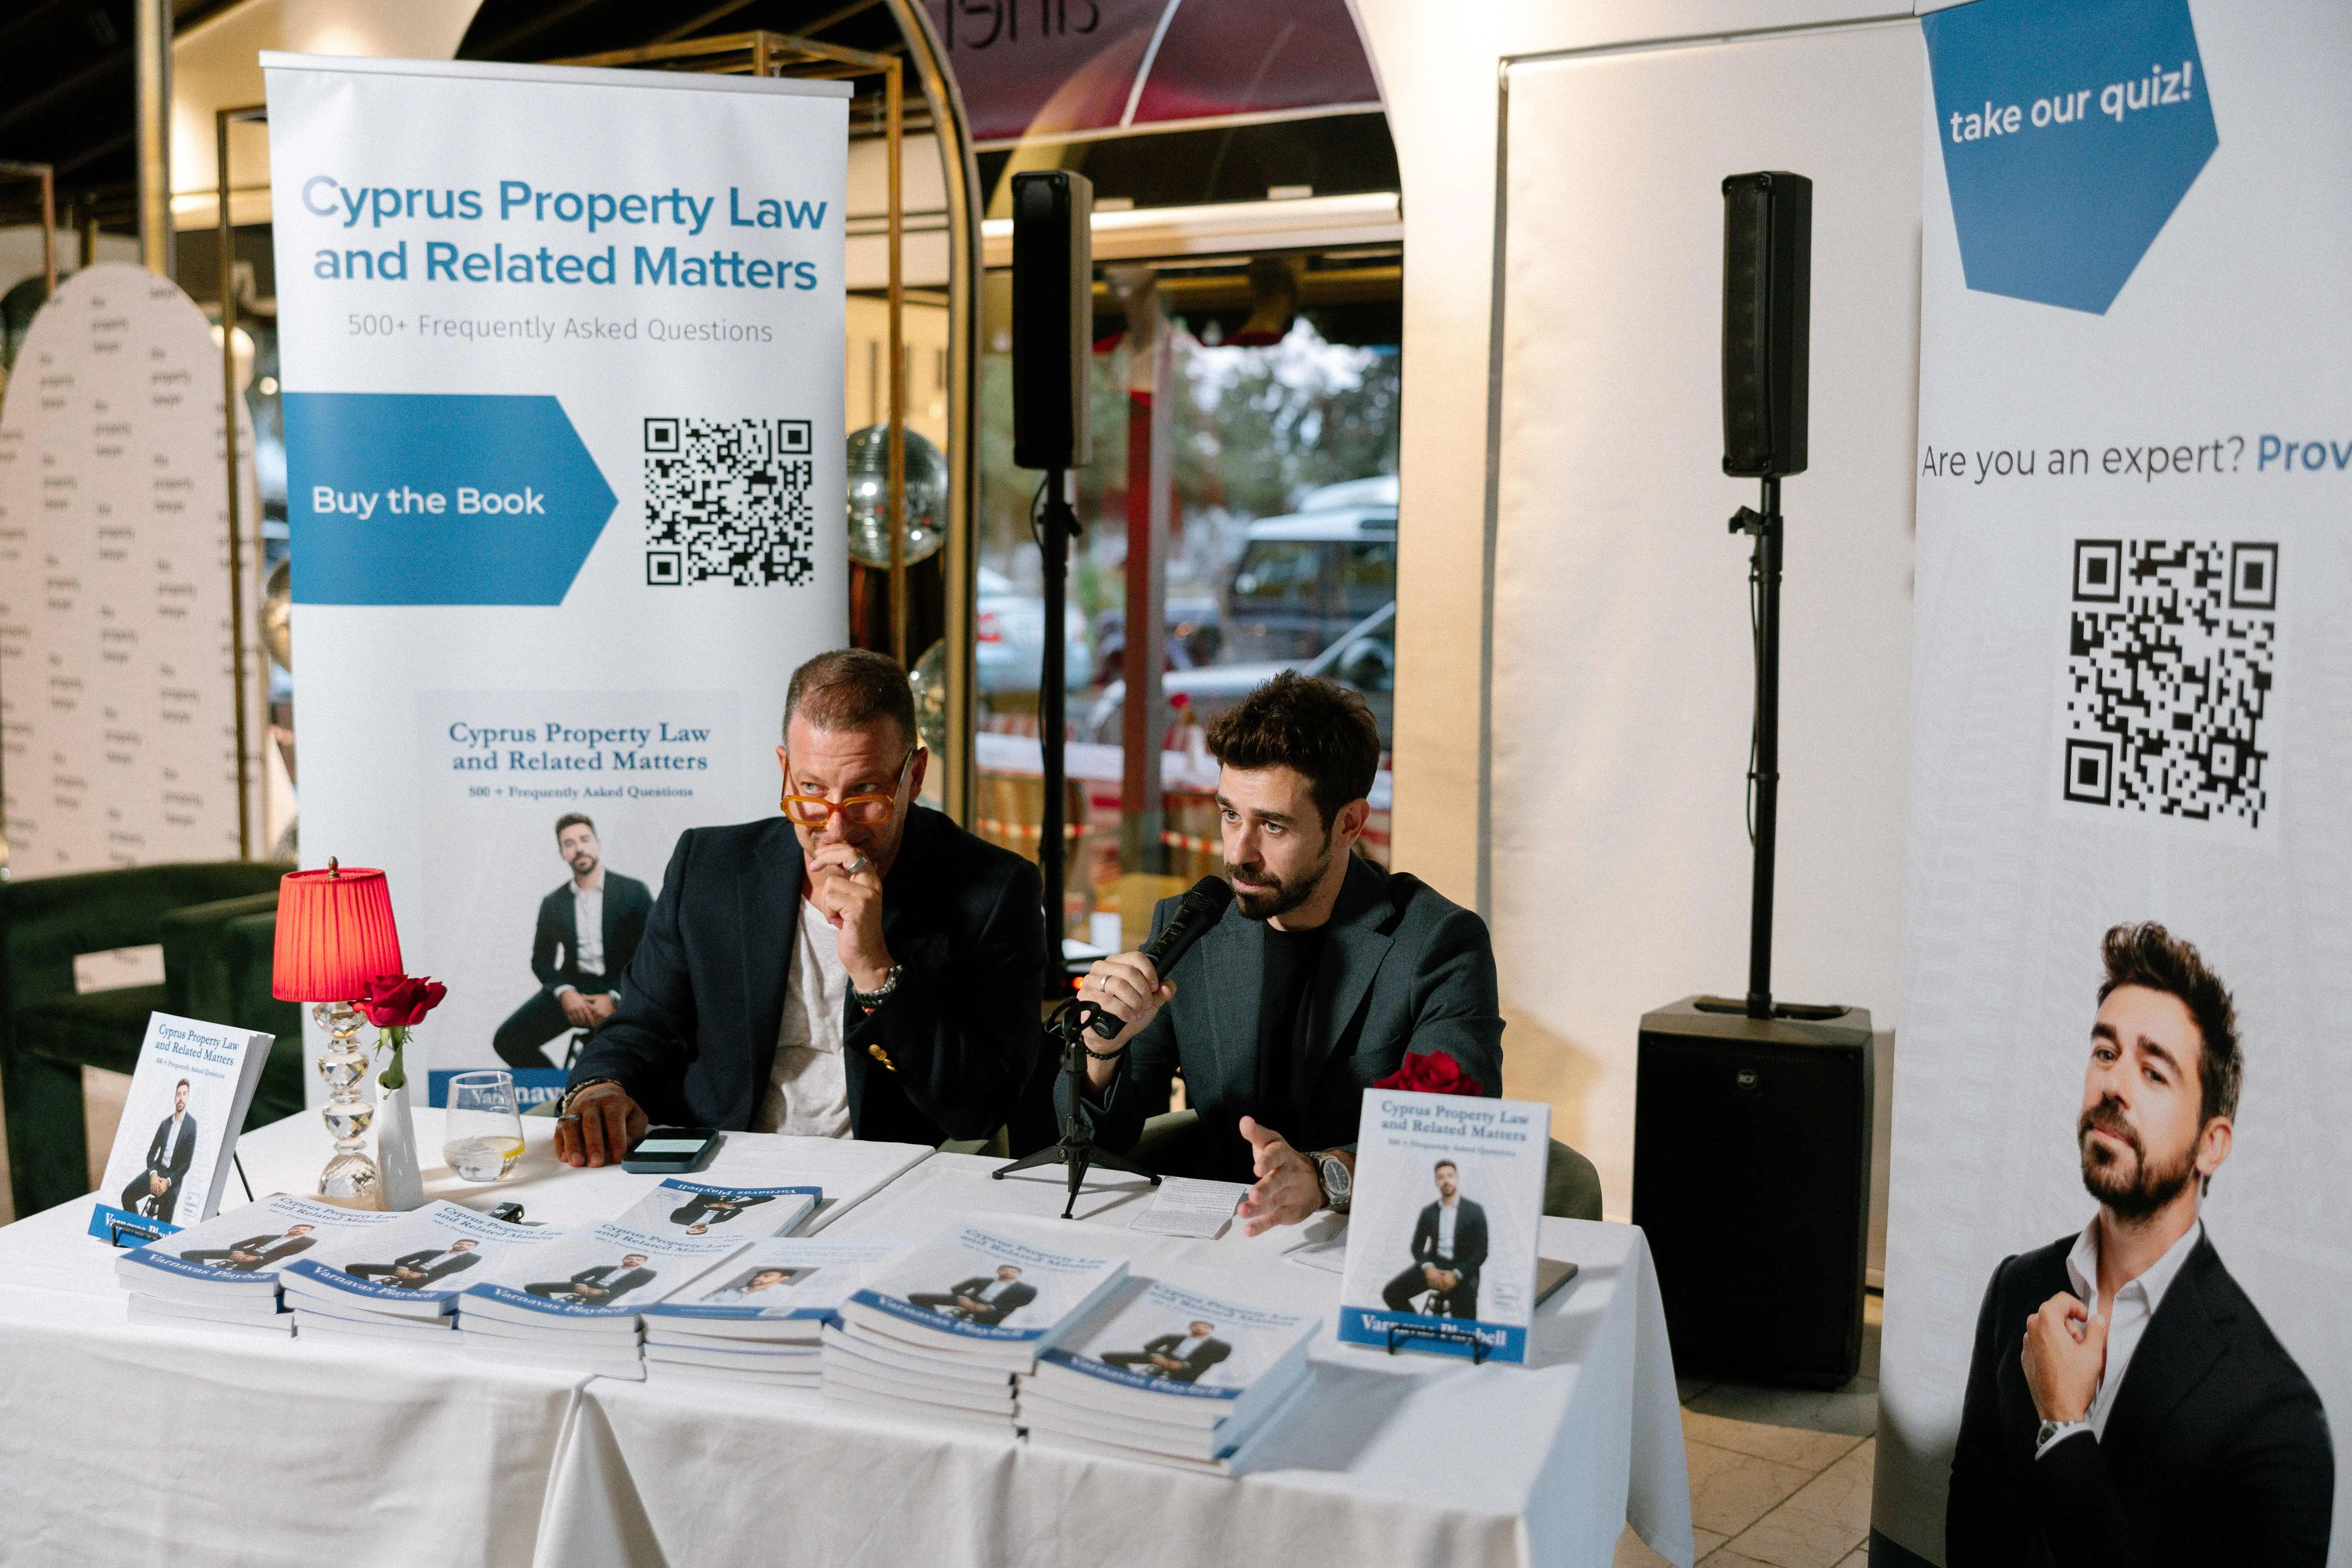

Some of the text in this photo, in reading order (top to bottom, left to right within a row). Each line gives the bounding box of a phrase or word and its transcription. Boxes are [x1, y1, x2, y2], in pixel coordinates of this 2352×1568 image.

[1950, 61, 2193, 143] take our quiz!
[302, 175, 827, 236] Cyprus Property Law
[313, 241, 818, 291] and Related Matters
[348, 314, 772, 343] 500+ Frequently Asked Questions
[1922, 445, 1966, 477] Are
[1975, 450, 2035, 484] you
[2048, 449, 2088, 474] an
[2102, 436, 2245, 482] expert?
[312, 486, 545, 520] Buy the Book
[449, 722, 710, 749] Cyprus Property Law
[453, 751, 707, 771] and Related Matters
[469, 787, 490, 797] 500
[509, 787, 577, 799] Frequently
[584, 787, 623, 797] Asked
[628, 787, 693, 798] Questions
[159, 1024, 239, 1050] Cyprus Property Law
[155, 1041, 234, 1066] and Related Matters
[168, 1060, 190, 1072] Frequently
[205, 1069, 225, 1079] Questions
[1382, 1100, 1430, 1117] Cyprus
[1436, 1105, 1494, 1124] Property
[1381, 1119, 1526, 1141] and Related Matters
[677, 1184, 732, 1195] Playbell
[280, 1197, 321, 1211] Cyprus
[323, 1208, 372, 1219] Property
[296, 1209, 343, 1221] Related
[444, 1207, 484, 1224] Cyprus
[487, 1222, 533, 1234] Property
[435, 1212, 459, 1222] and
[460, 1222, 507, 1236] Related
[602, 1224, 646, 1238] Cyprus
[623, 1237, 673, 1250] Related
[150, 1254, 272, 1279] Varnavas Playbell
[315, 1266, 438, 1297] Varnavas Playbell
